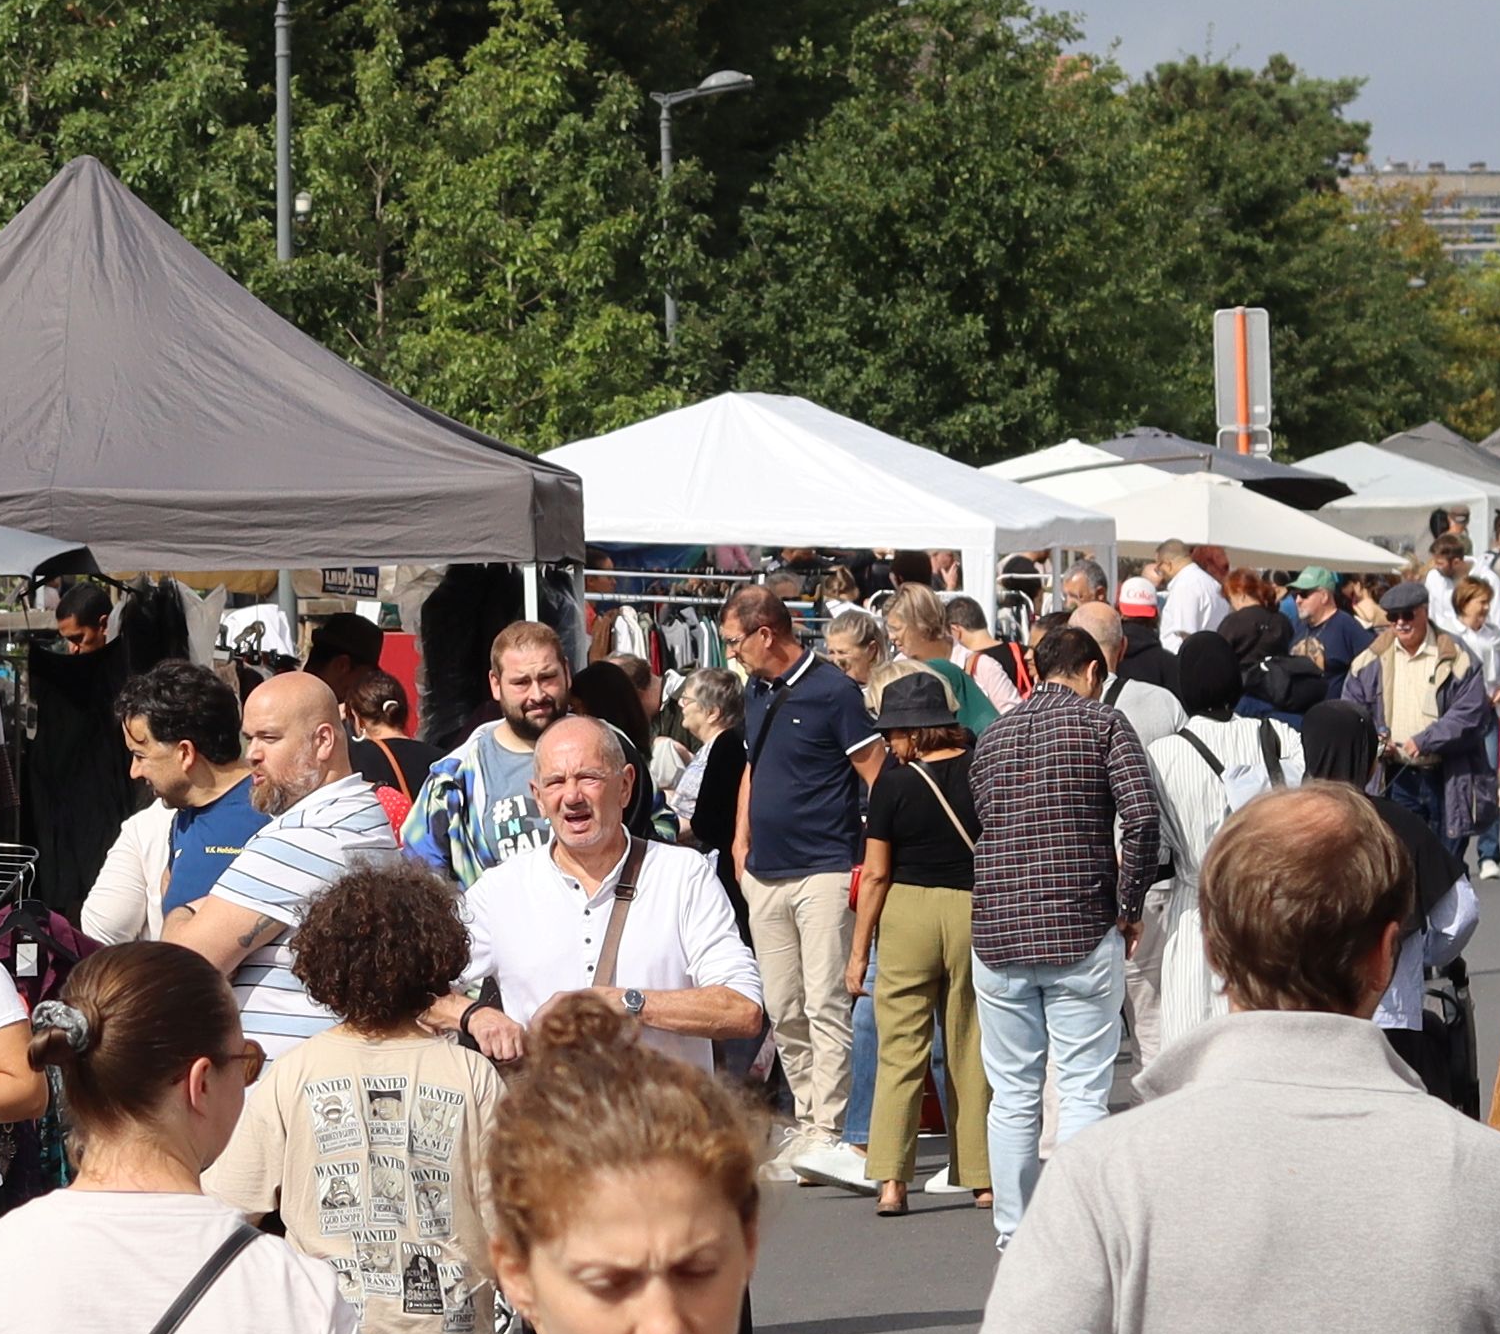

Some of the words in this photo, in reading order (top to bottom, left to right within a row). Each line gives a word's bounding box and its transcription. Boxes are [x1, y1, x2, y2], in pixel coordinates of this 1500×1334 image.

[324, 568, 377, 589] LAVAZZA
[305, 1078, 351, 1095] WANTED
[362, 1077, 407, 1090] WANTED
[419, 1085, 464, 1106] WANTED
[315, 1162, 360, 1177] WANTED
[369, 1153, 406, 1170] WANTED
[411, 1170, 450, 1182] WANTED
[353, 1230, 397, 1242] WANTED
